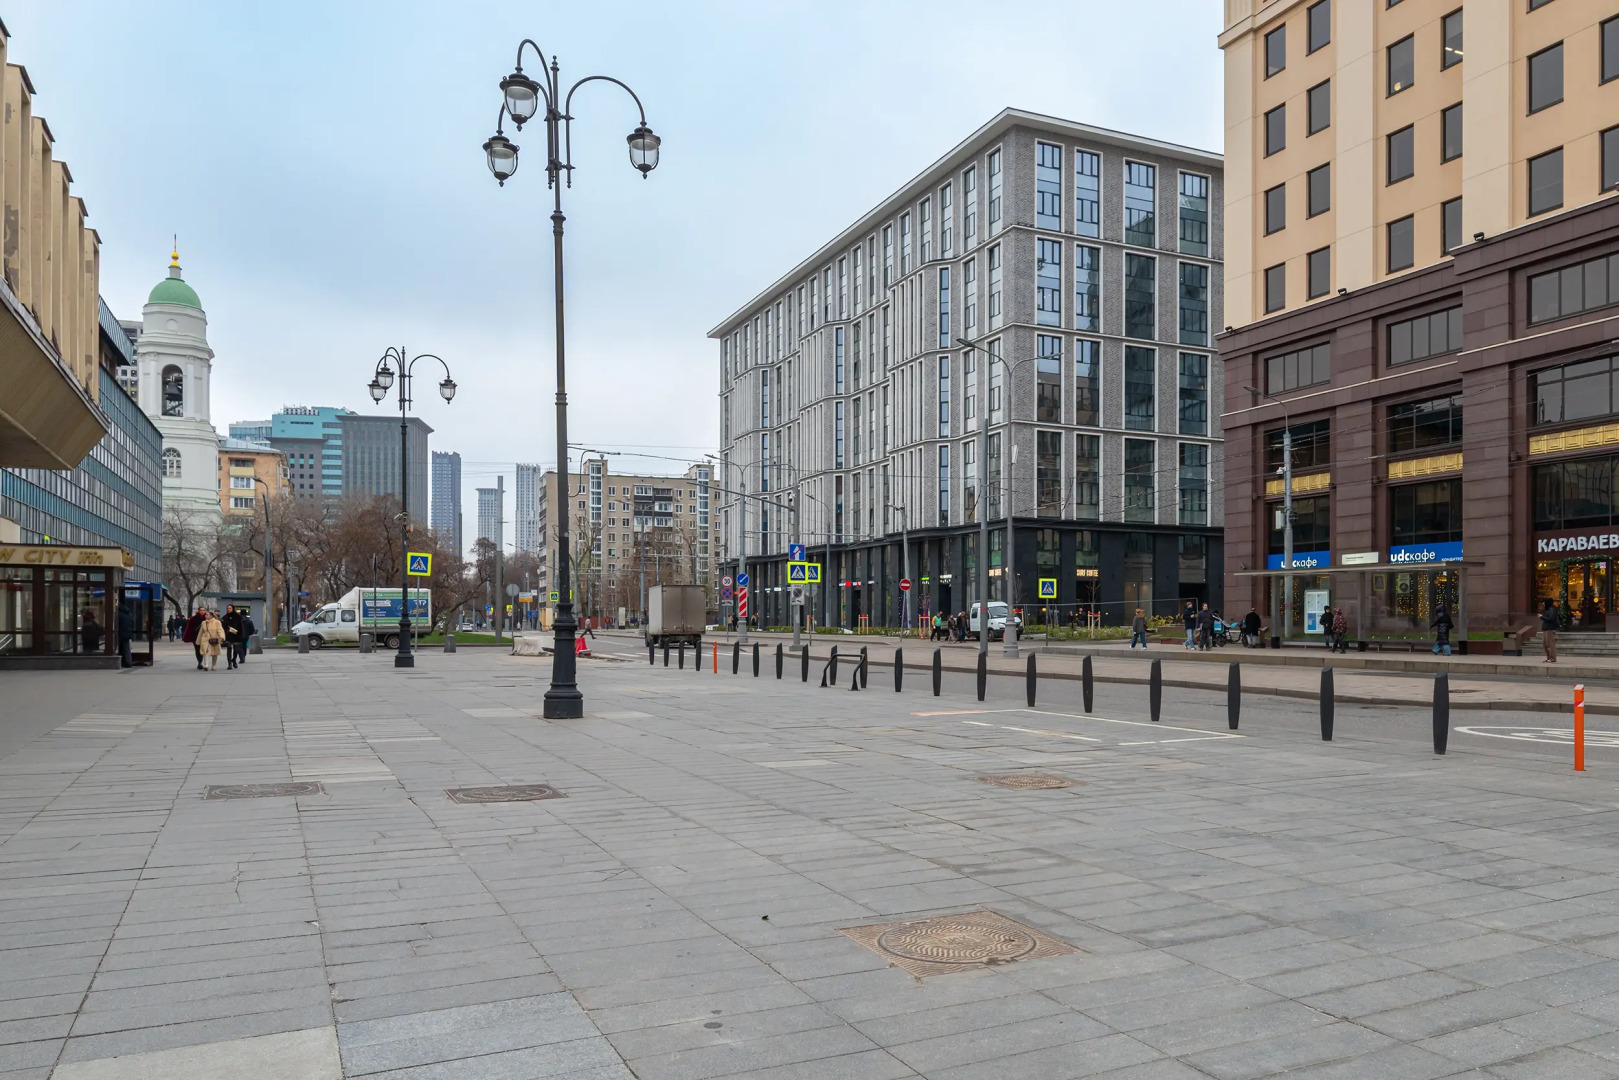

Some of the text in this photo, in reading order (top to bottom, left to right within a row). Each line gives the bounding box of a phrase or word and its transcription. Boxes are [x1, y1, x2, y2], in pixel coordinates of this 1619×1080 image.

[1538, 534, 1619, 552] КАРАВАЕВ
[24, 549, 71, 564] CITY
[724, 577, 731, 585] 30
